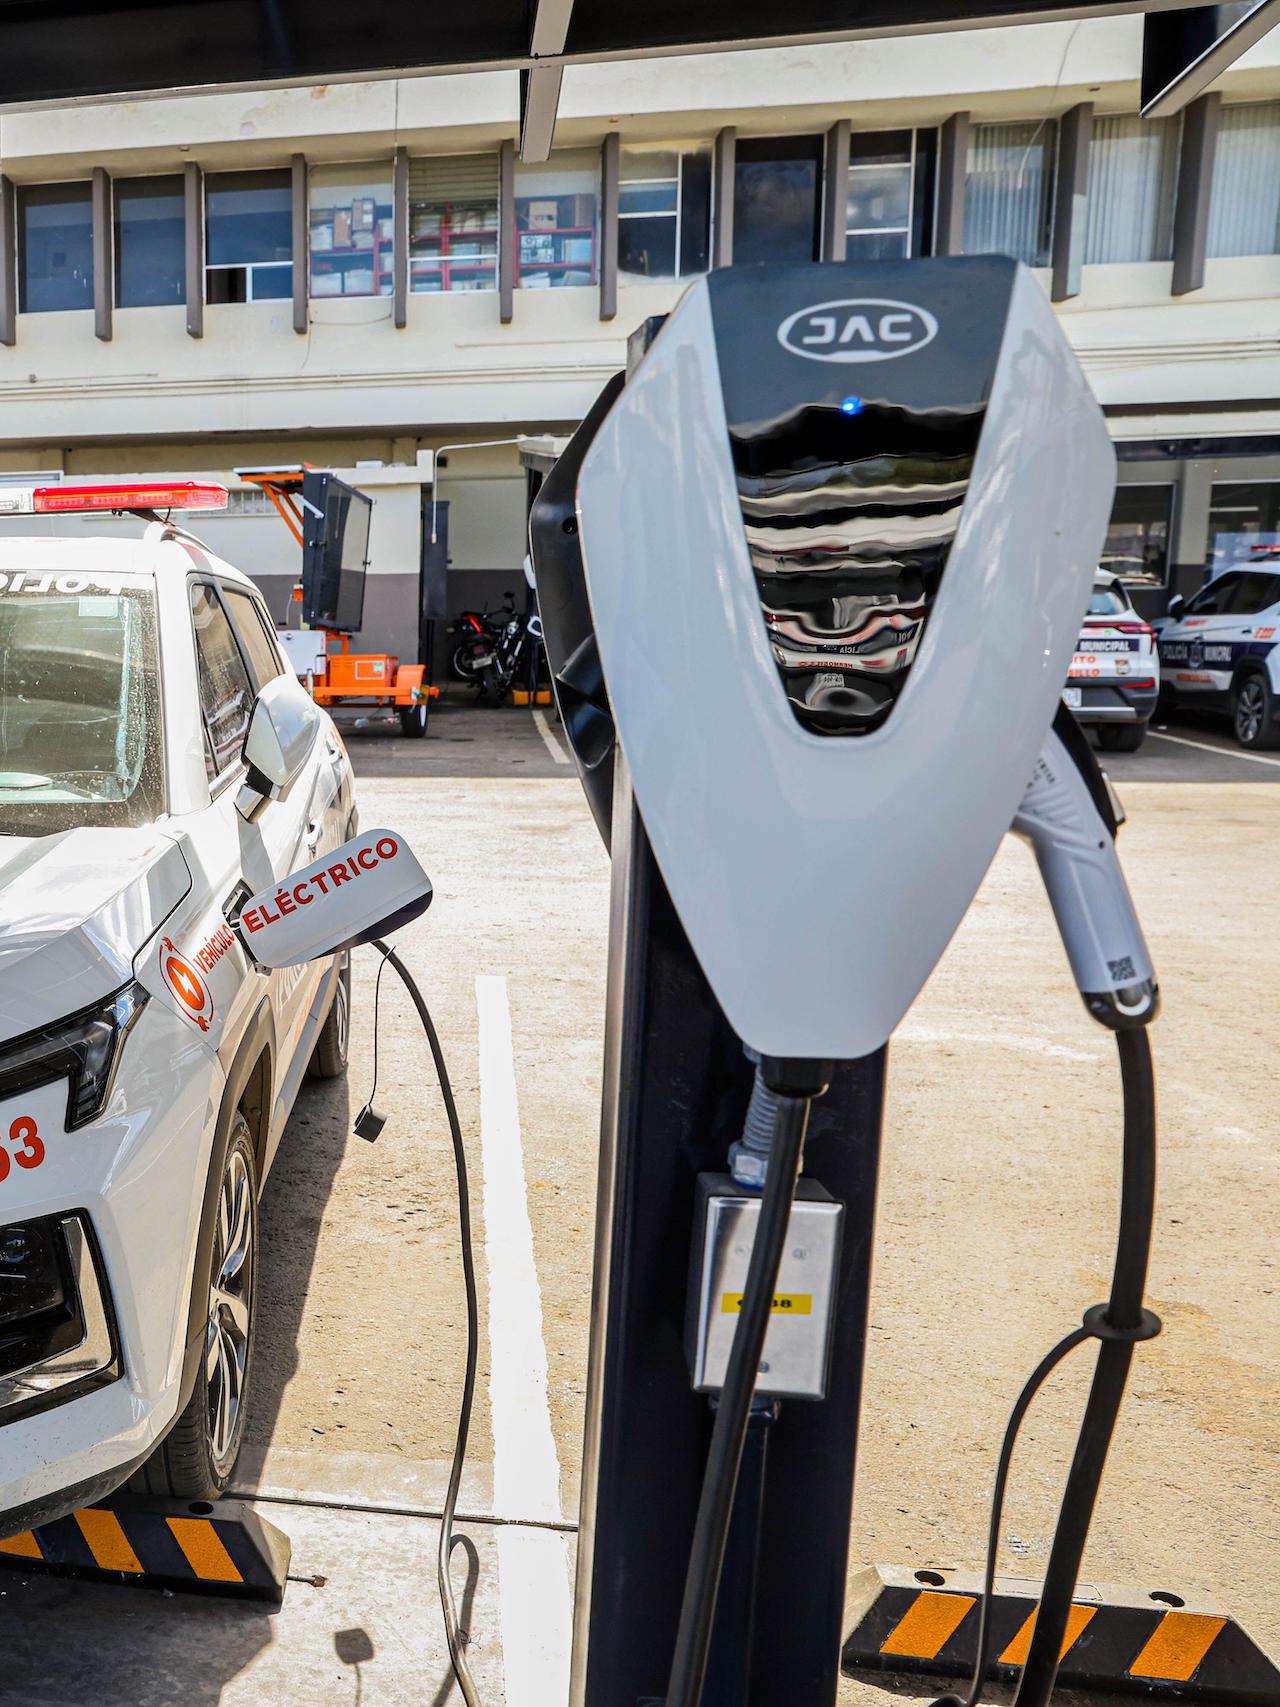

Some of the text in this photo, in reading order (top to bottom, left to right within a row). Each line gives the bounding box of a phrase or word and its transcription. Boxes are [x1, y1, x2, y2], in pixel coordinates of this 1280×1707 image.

[801, 313, 913, 345] JAC
[1079, 640, 1130, 653] MUNICIPAL
[242, 837, 399, 934] ELÉCTRICO
[193, 922, 236, 975] VEHÍCULO
